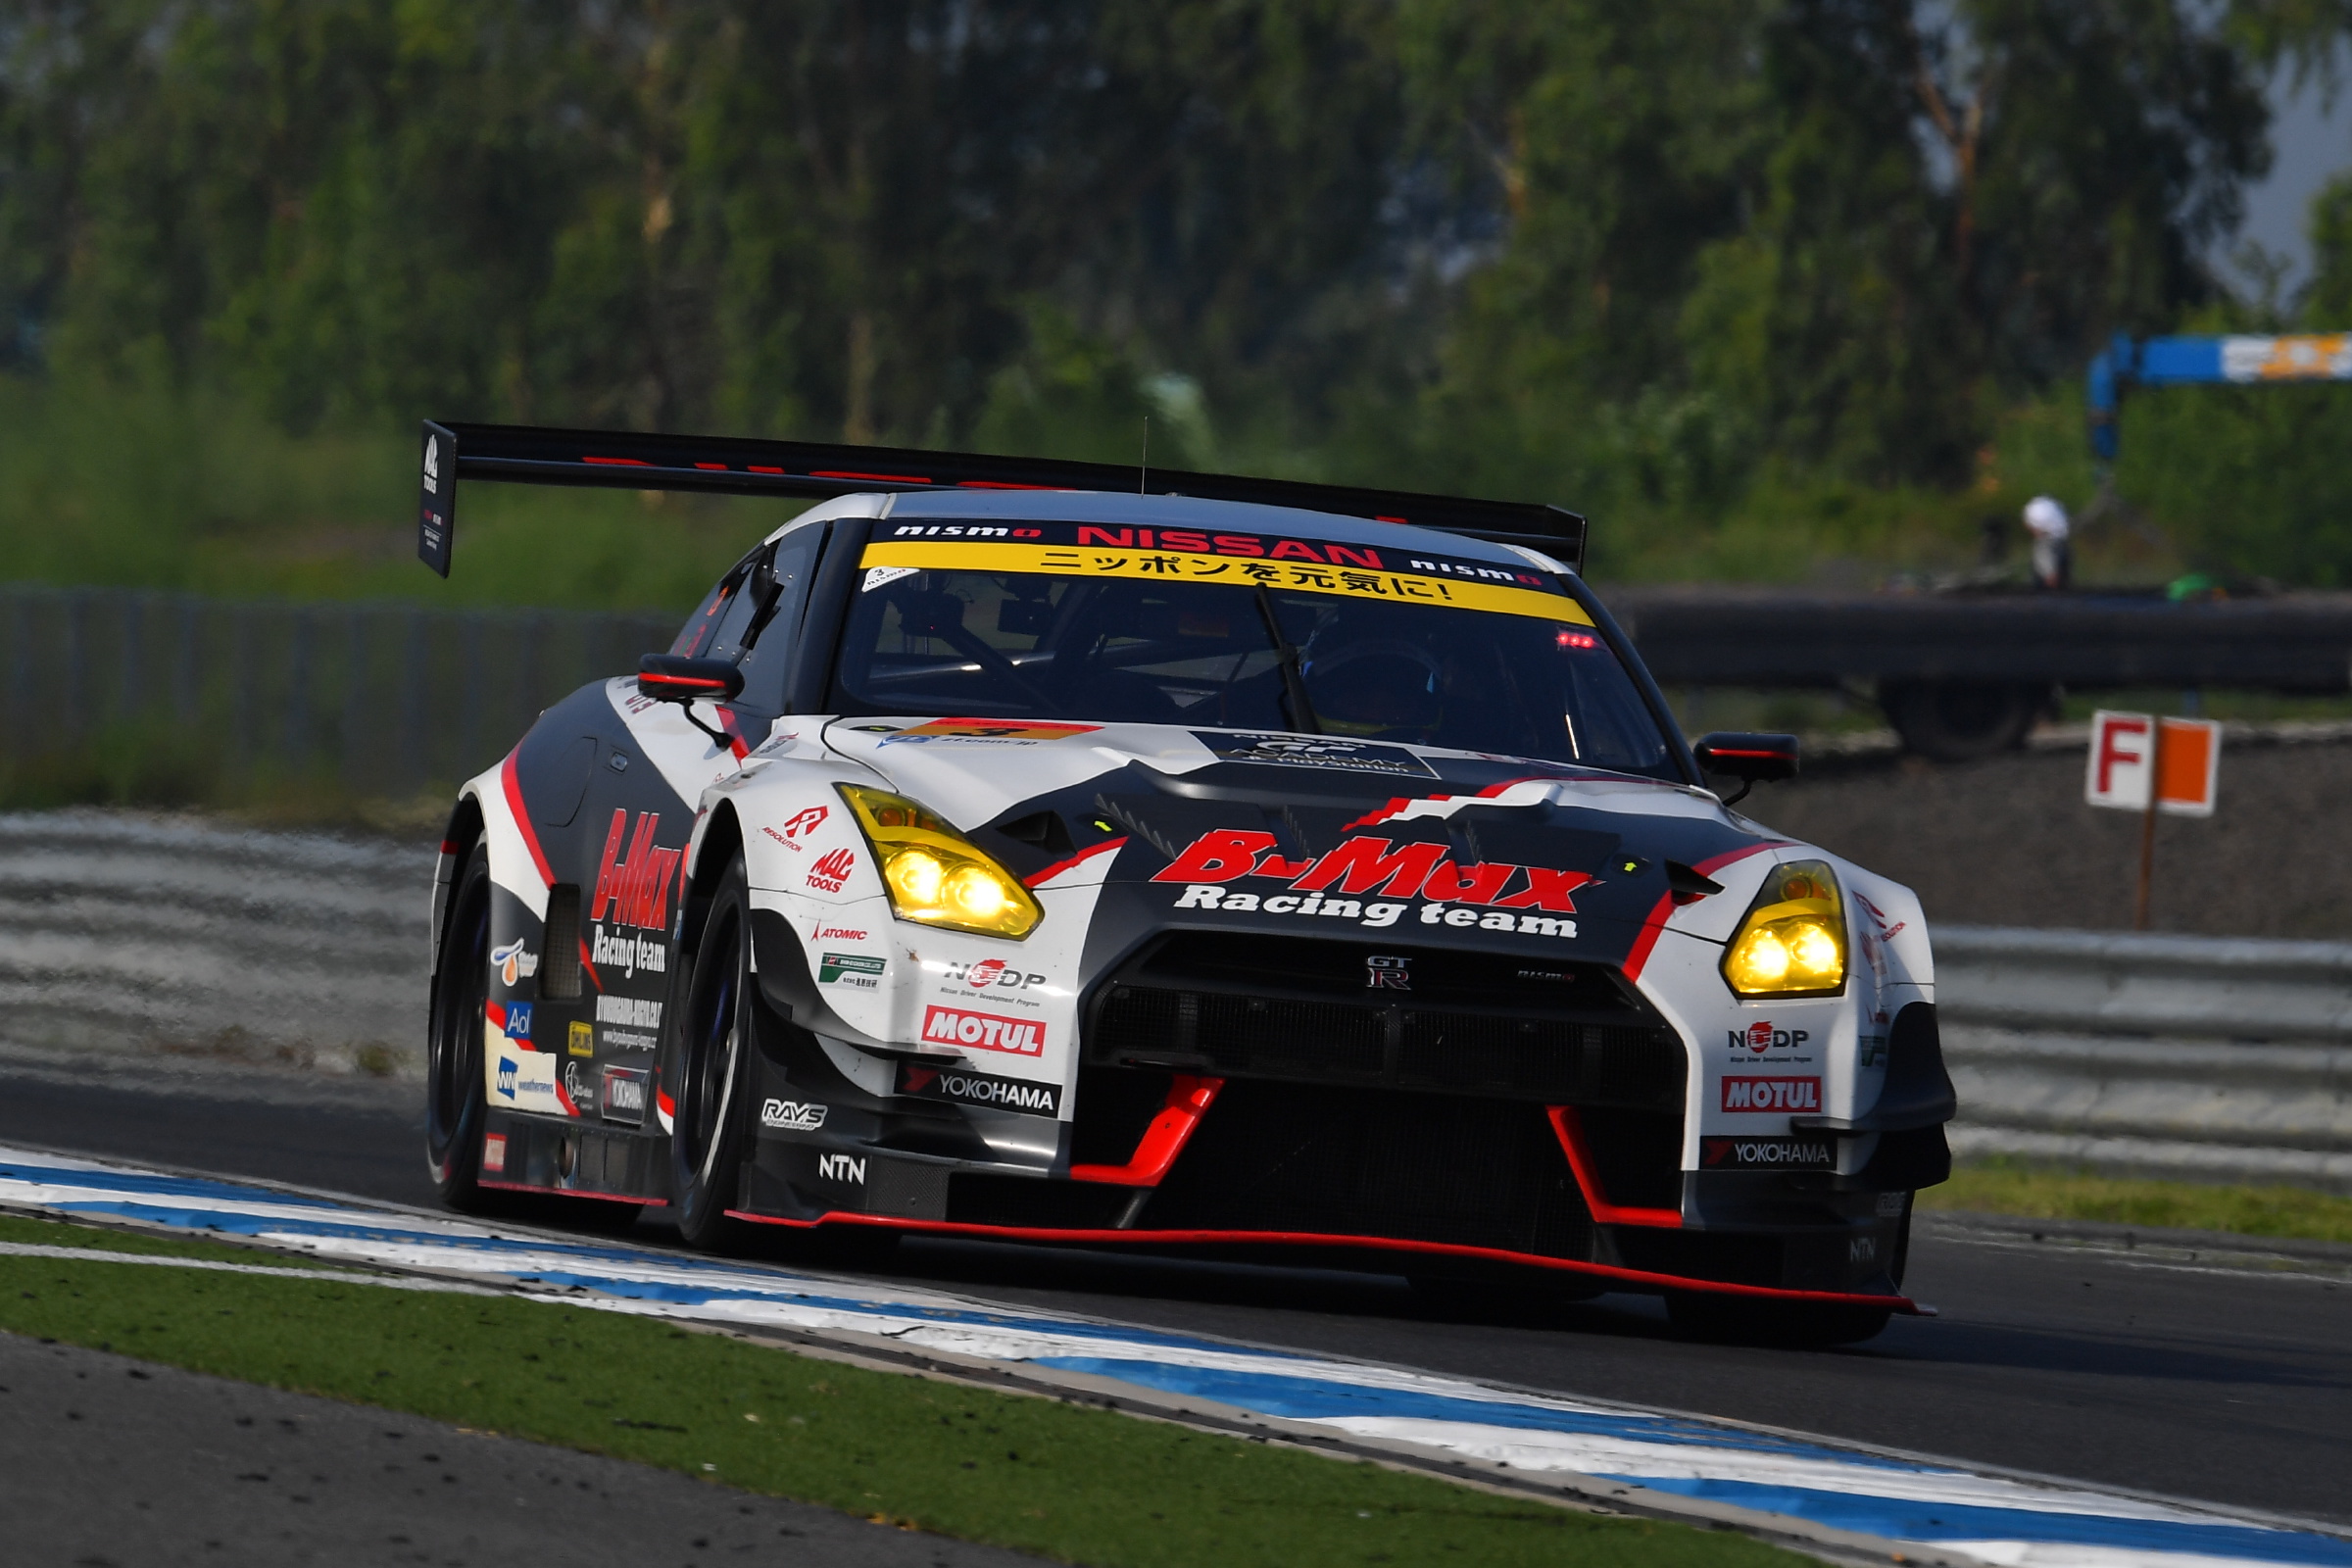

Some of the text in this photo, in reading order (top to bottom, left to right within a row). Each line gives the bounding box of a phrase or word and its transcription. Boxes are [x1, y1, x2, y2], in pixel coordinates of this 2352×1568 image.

[894, 525, 1543, 586] nismo NISSAN nismo
[1233, 734, 1367, 749] NISSAN
[1229, 749, 1406, 766] ACADEMY
[1276, 758, 1409, 773] PlayStation
[2096, 720, 2147, 794] F
[761, 826, 803, 853] RESOLUTION
[590, 808, 682, 931] B-Max
[809, 848, 855, 882] MAC
[1150, 829, 1607, 914] B-Max
[806, 874, 843, 893] TOOLS
[1173, 883, 1579, 939] Racing team
[821, 928, 867, 941] ATOMIC
[591, 924, 635, 979] Racing
[635, 932, 666, 973] team
[1366, 956, 1413, 968] GT
[1366, 968, 1412, 991] R
[1517, 970, 1575, 983] nismo
[979, 993, 1014, 1004] Development
[1016, 998, 1040, 1007] Program
[926, 1011, 1040, 1053] MOTUL
[939, 1074, 1054, 1111] YOKOHAMA
[1726, 1081, 1817, 1108] MOTUL
[763, 1102, 825, 1123] RAYS
[1735, 1143, 1830, 1163] YOKOHAMA
[819, 1154, 866, 1186] NTN
